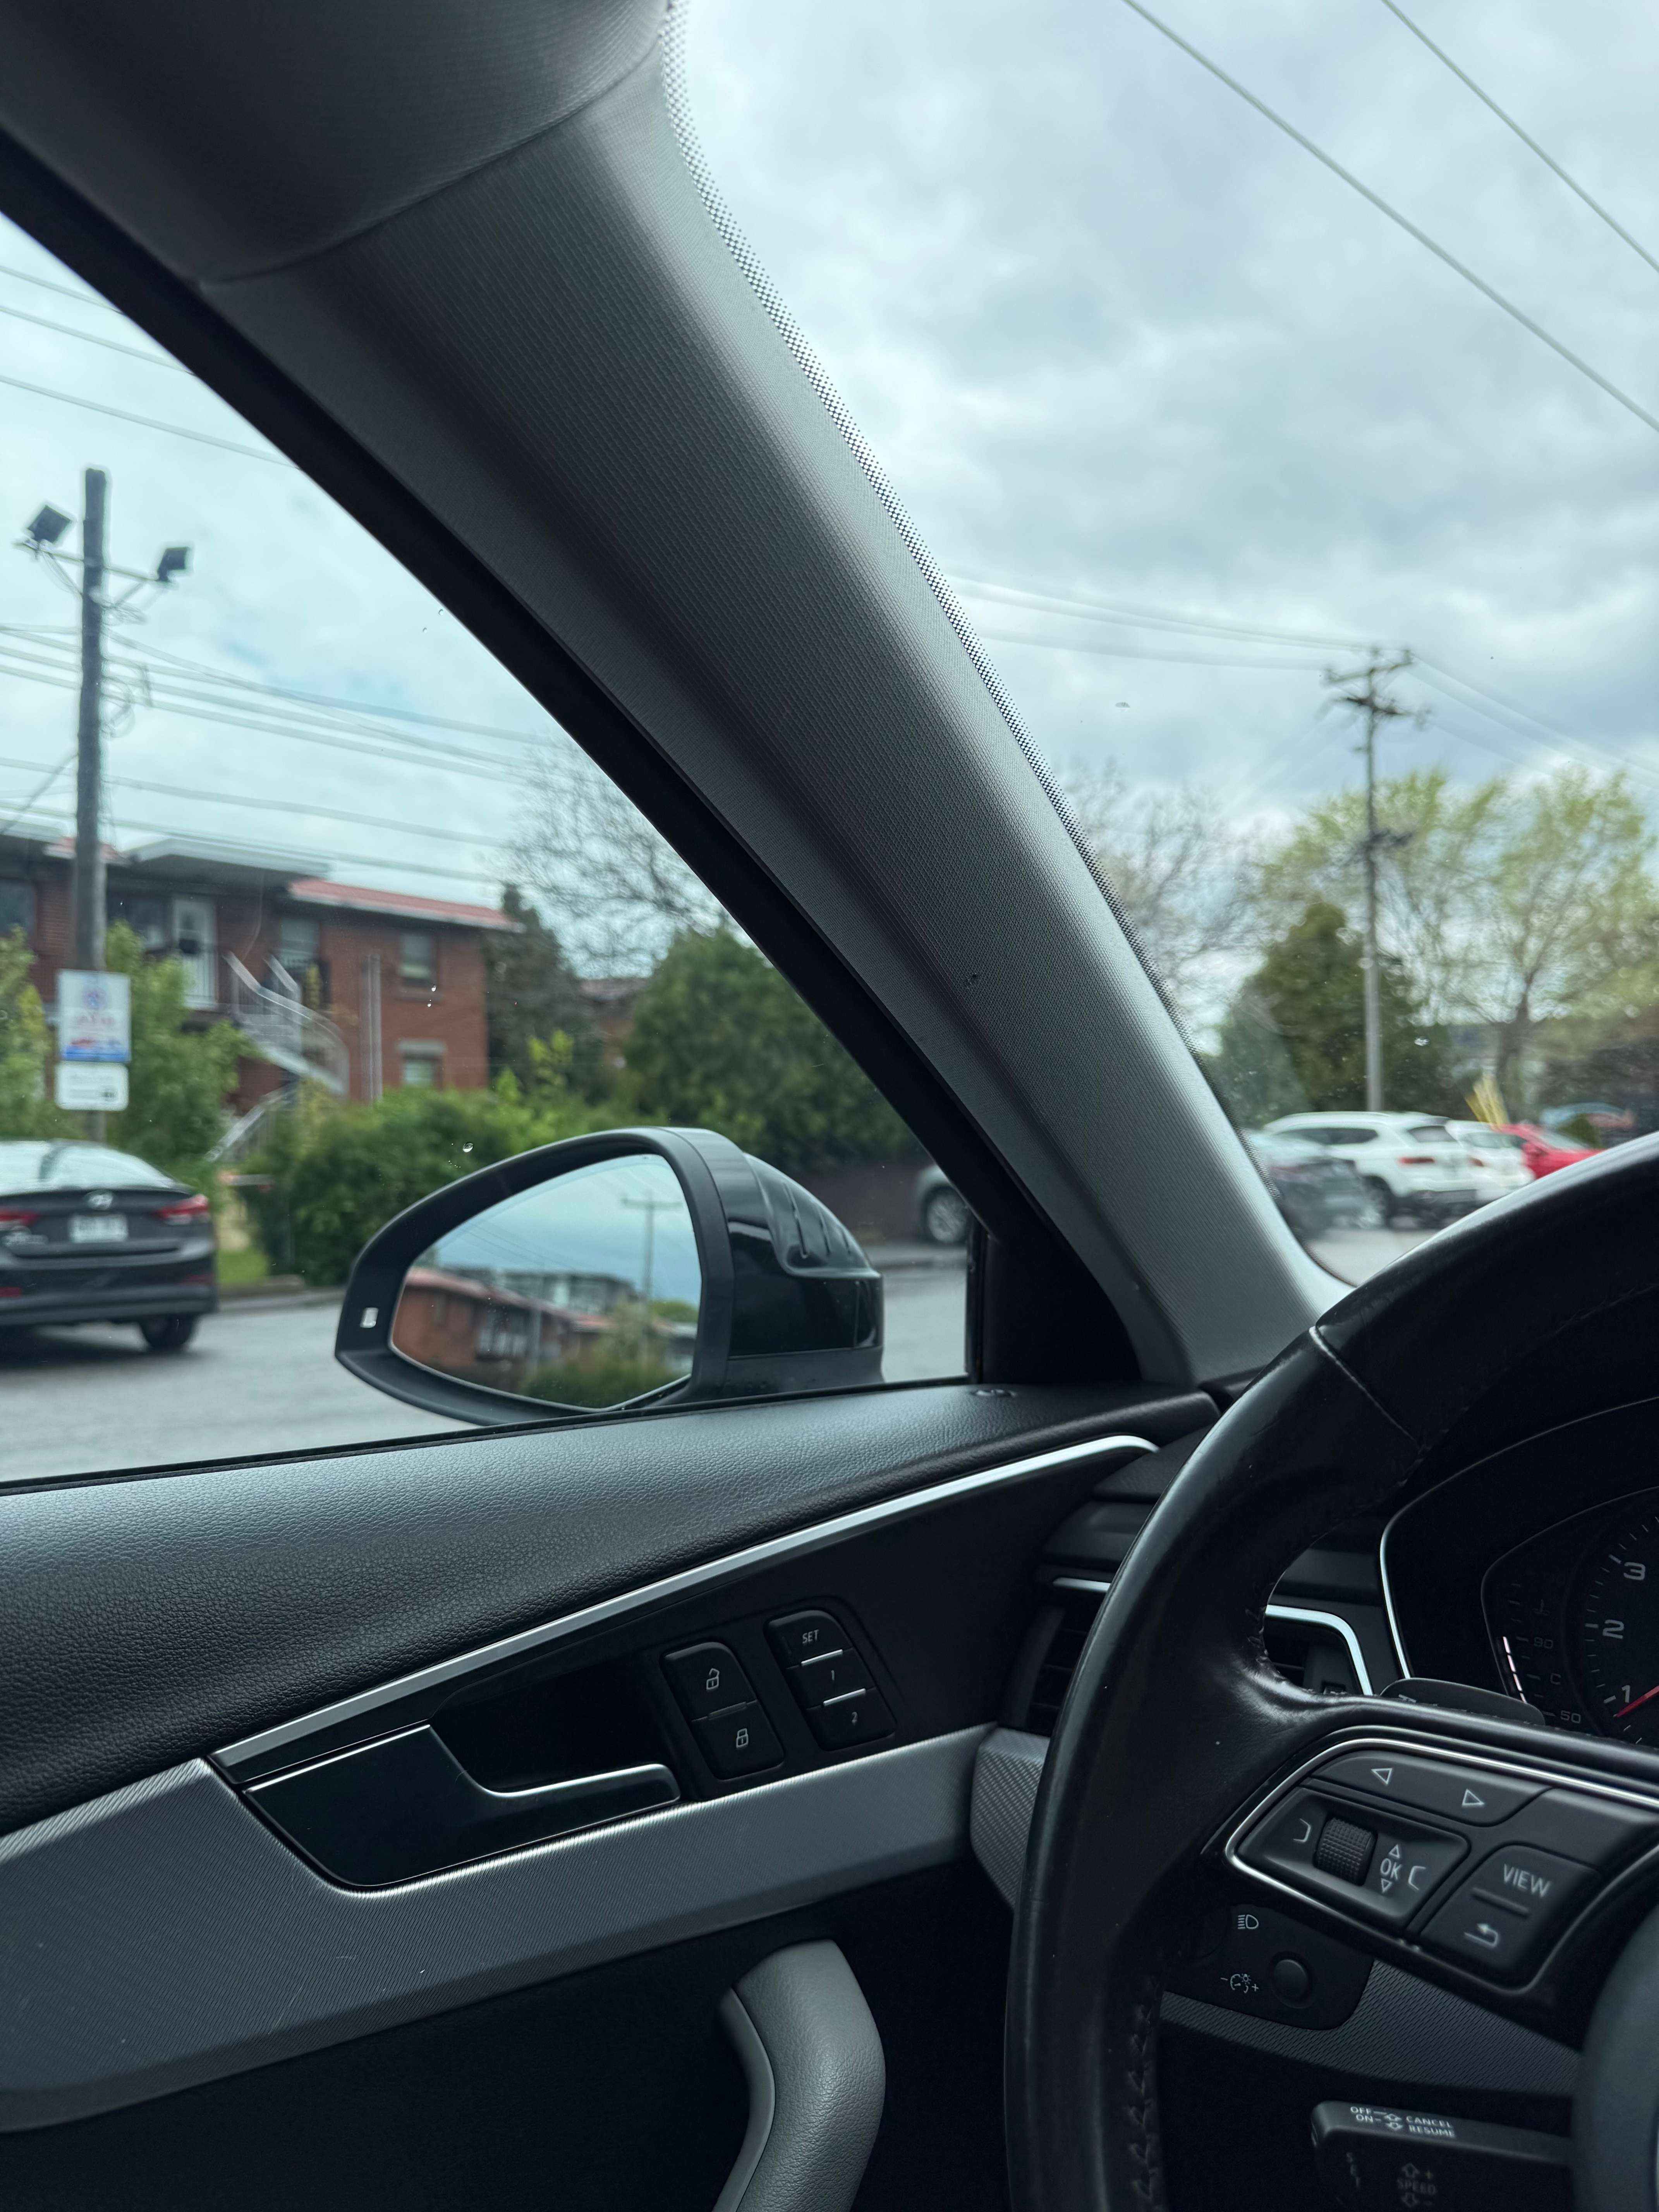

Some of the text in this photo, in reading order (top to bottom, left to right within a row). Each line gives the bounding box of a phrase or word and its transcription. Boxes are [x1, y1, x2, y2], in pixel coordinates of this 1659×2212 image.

[1623, 1562, 1646, 1580] 3
[1602, 1619, 1625, 1639] 2
[802, 1629, 819, 1645] SET
[831, 1670, 835, 1681] 1
[1550, 1672, 1561, 1685] C
[1621, 1685, 1631, 1703] 1
[852, 1712, 858, 1725] 2
[1560, 1709, 1581, 1724] 50
[1380, 1858, 1401, 1881] OK
[1503, 1863, 1552, 1898] VIEW
[1350, 2106, 1372, 2115] OFF
[1355, 2114, 1374, 2123] ON
[1406, 2116, 1453, 2128] CANCEL
[1408, 2124, 1456, 2138] RESUME
[1396, 2178, 1437, 2195] SPEED
